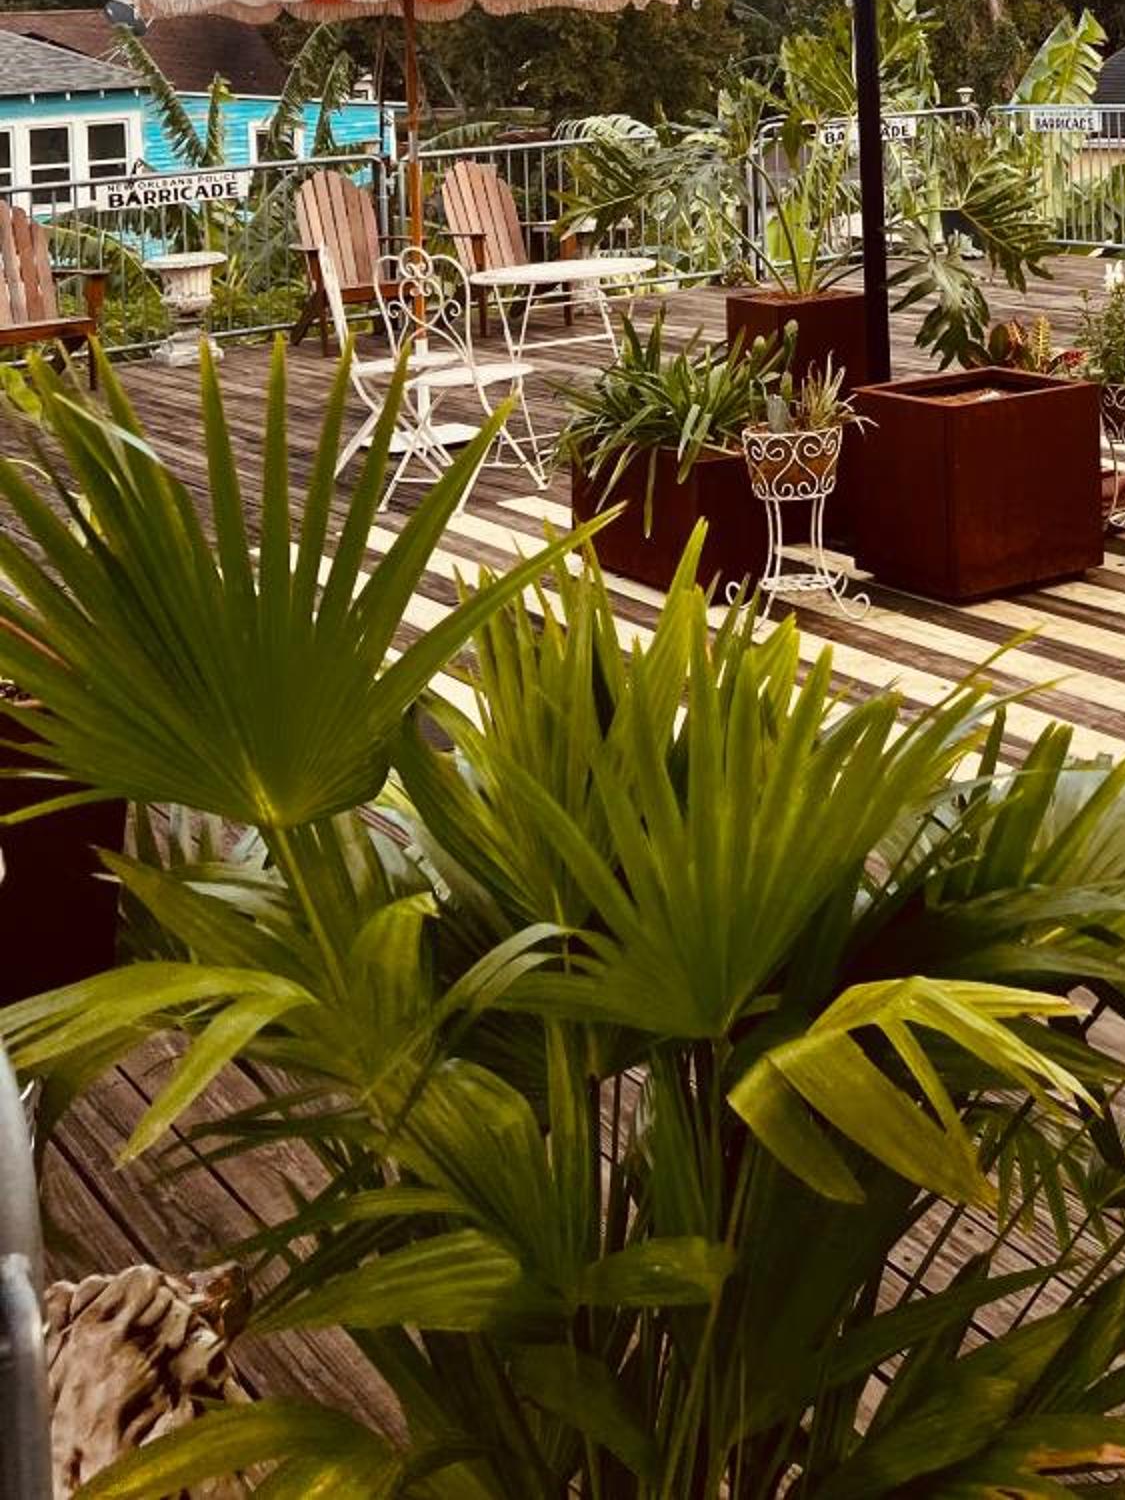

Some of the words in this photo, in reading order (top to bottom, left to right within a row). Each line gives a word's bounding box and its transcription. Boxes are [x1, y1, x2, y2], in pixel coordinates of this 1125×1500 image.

[824, 125, 911, 145] BAADE
[107, 182, 135, 193] NEW
[137, 177, 194, 190] ORLEANS
[197, 172, 237, 183] POLICE
[108, 181, 239, 208] BARRICADE
